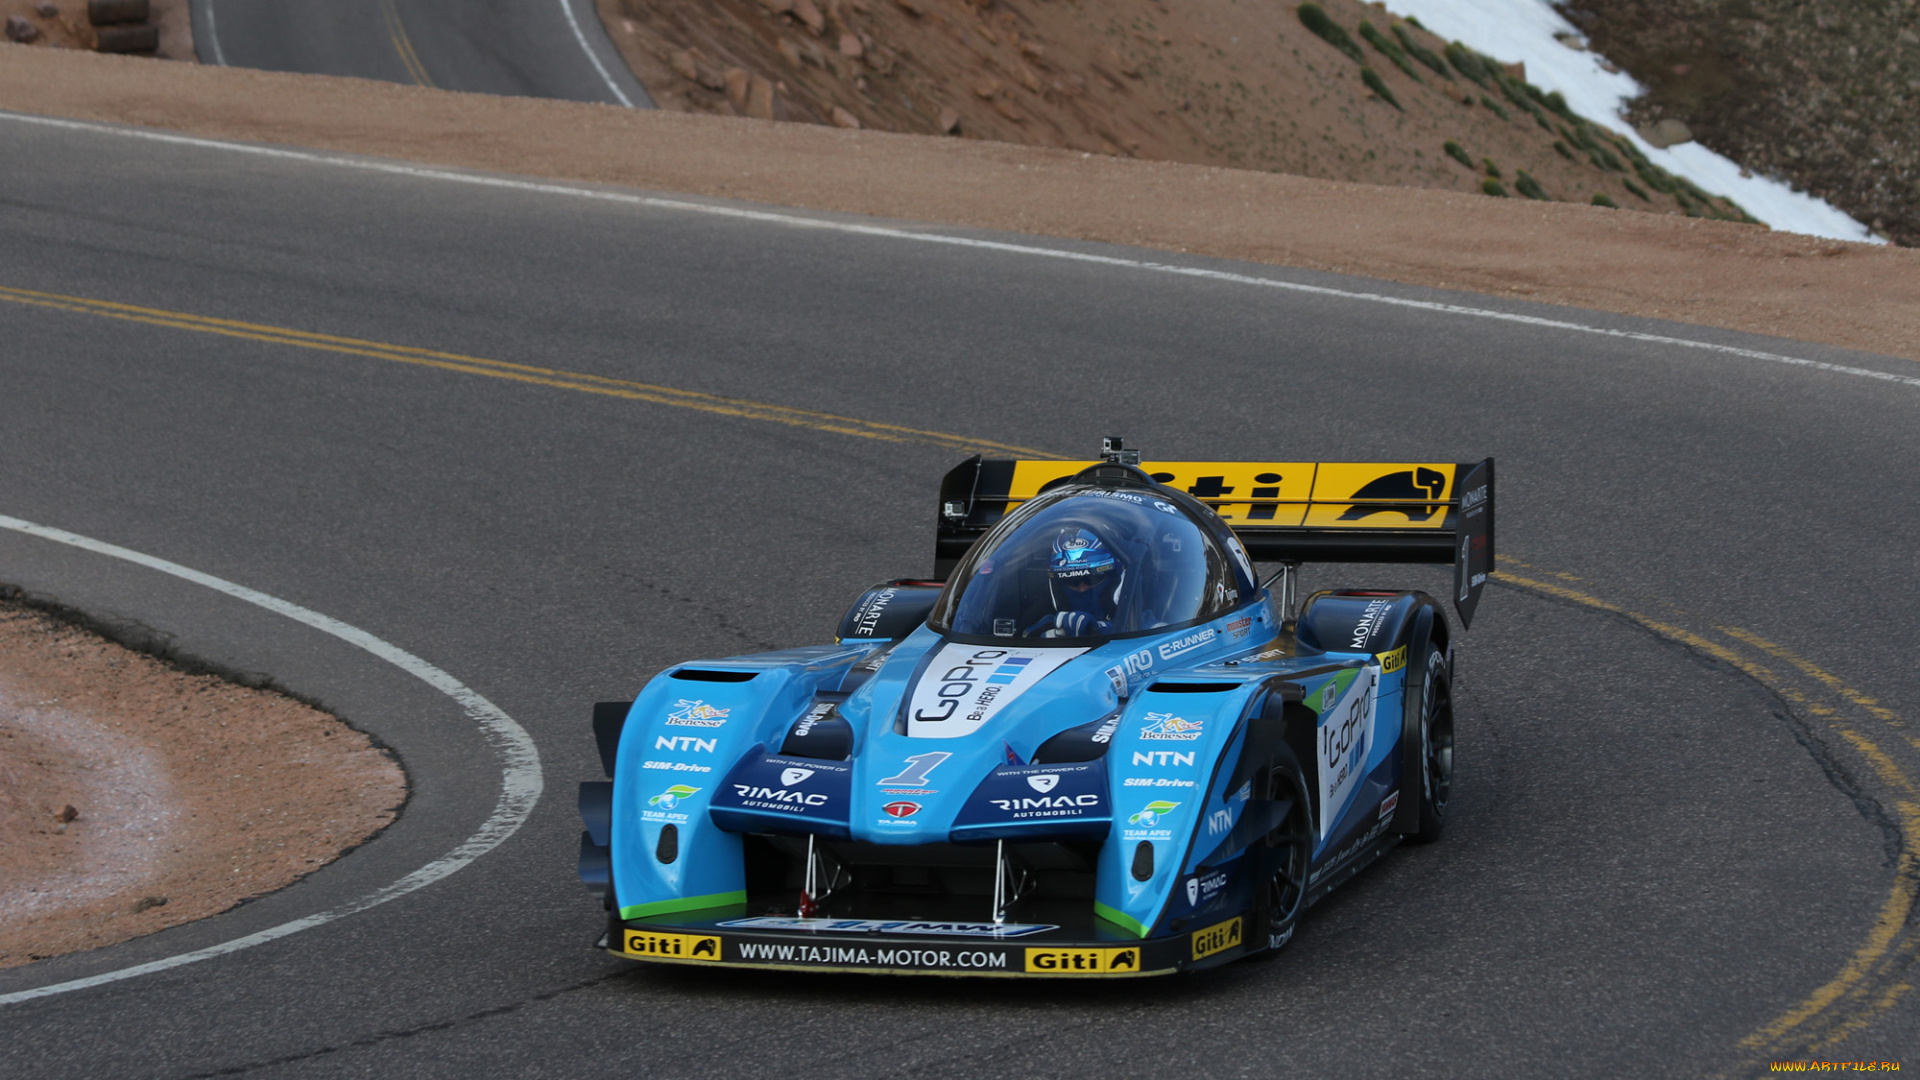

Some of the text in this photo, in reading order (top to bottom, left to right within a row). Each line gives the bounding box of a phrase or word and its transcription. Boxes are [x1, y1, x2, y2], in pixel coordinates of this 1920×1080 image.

[1058, 569, 1090, 578] TAJIMA
[858, 587, 898, 636] MONARTE
[1350, 599, 1387, 649] MONARTE
[1383, 653, 1400, 671] Giti
[915, 650, 1008, 722] GoPro
[667, 716, 724, 728] Benesse
[1329, 686, 1370, 769] GoPro
[654, 735, 718, 753] NTN
[1140, 731, 1200, 741] Benesse
[642, 760, 711, 773] SIM-Drive
[803, 763, 835, 772] POWER
[1132, 751, 1195, 767] NTN
[876, 750, 954, 787] 1
[1123, 778, 1195, 788] SIM-Drive
[642, 810, 667, 819] TEAM
[742, 800, 806, 812] AUTOMOBILI
[1013, 809, 1083, 818] AUTOMOBILI
[1208, 807, 1233, 836] NTN
[1123, 829, 1172, 837] TEAM APEV
[628, 935, 681, 955] Giti
[1195, 929, 1225, 955] Giti
[739, 943, 1007, 968] WWW.TAJIMA-MOTOR.COM
[1032, 953, 1098, 970] Giti
